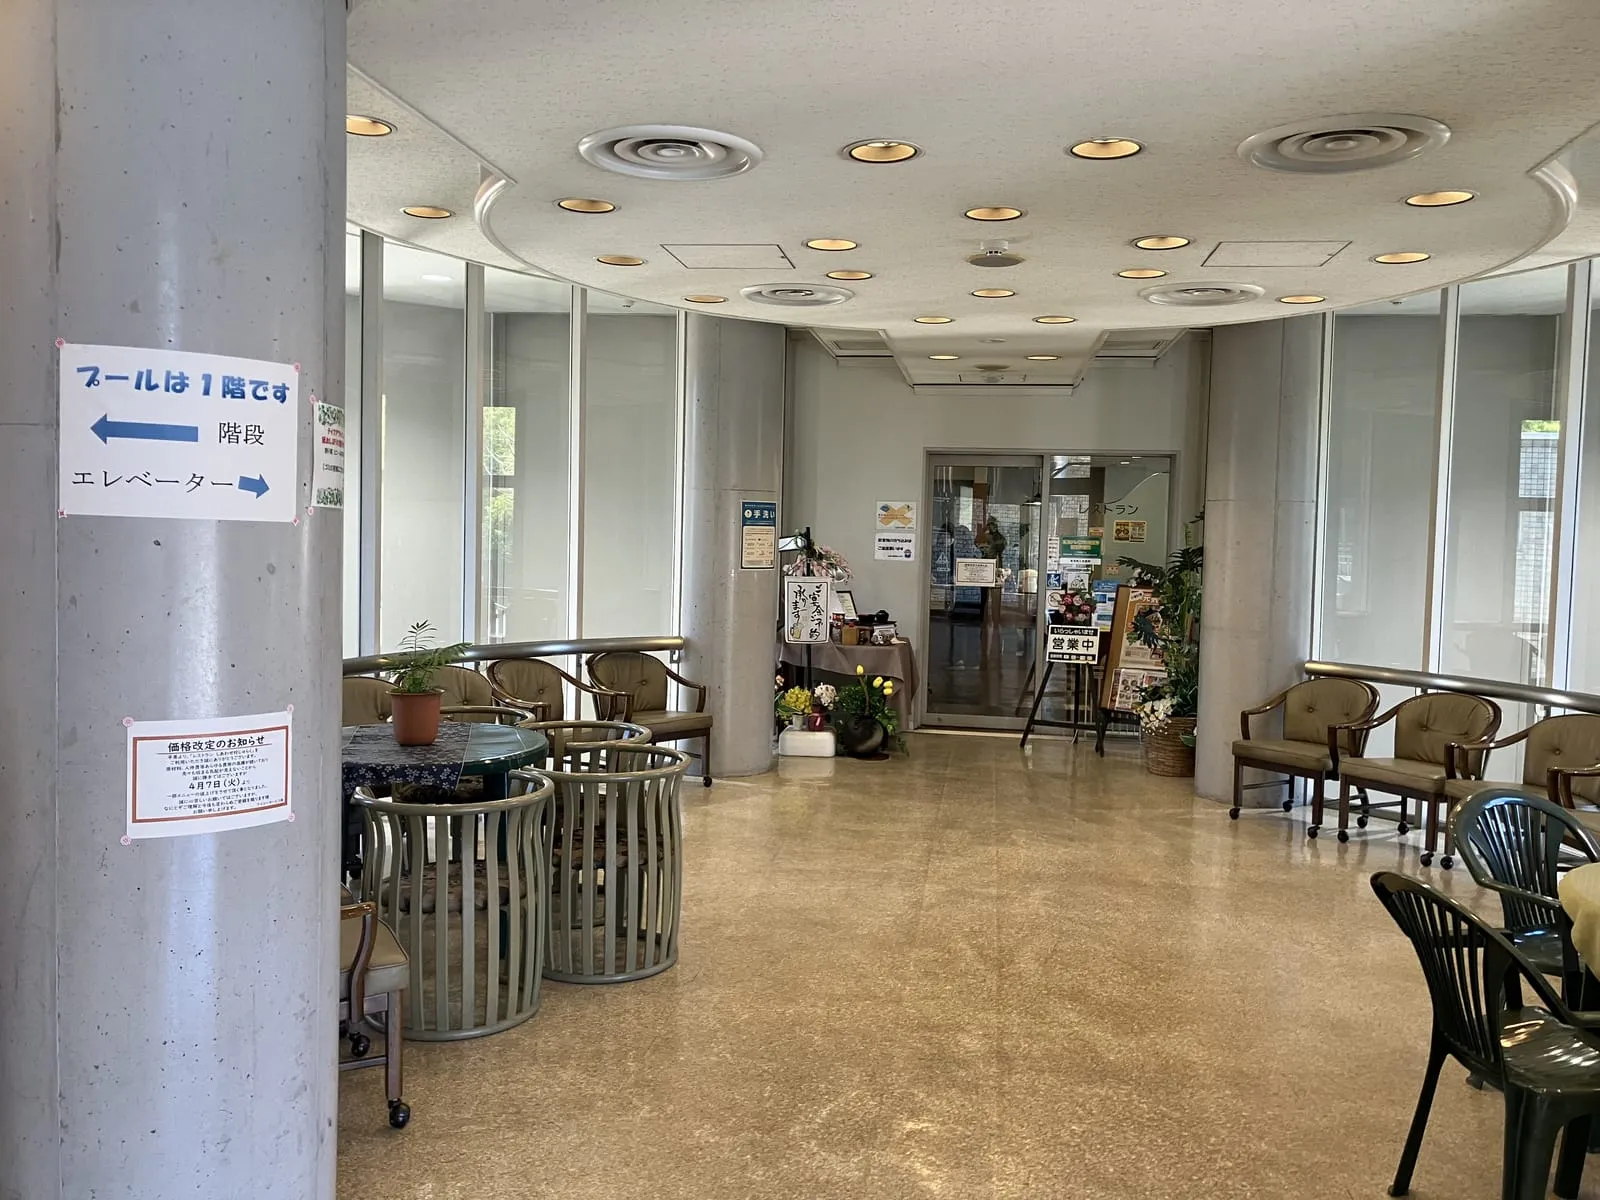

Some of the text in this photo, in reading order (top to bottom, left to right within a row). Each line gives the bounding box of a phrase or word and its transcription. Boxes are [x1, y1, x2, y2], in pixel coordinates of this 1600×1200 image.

[76, 365, 290, 404] プールは1階です
[218, 422, 265, 446] 階段
[71, 470, 234, 493] エレベーター
[1079, 503, 1139, 515] レストラン
[1052, 636, 1094, 652] 営業中
[168, 735, 265, 753] 価格改定のお知らせ
